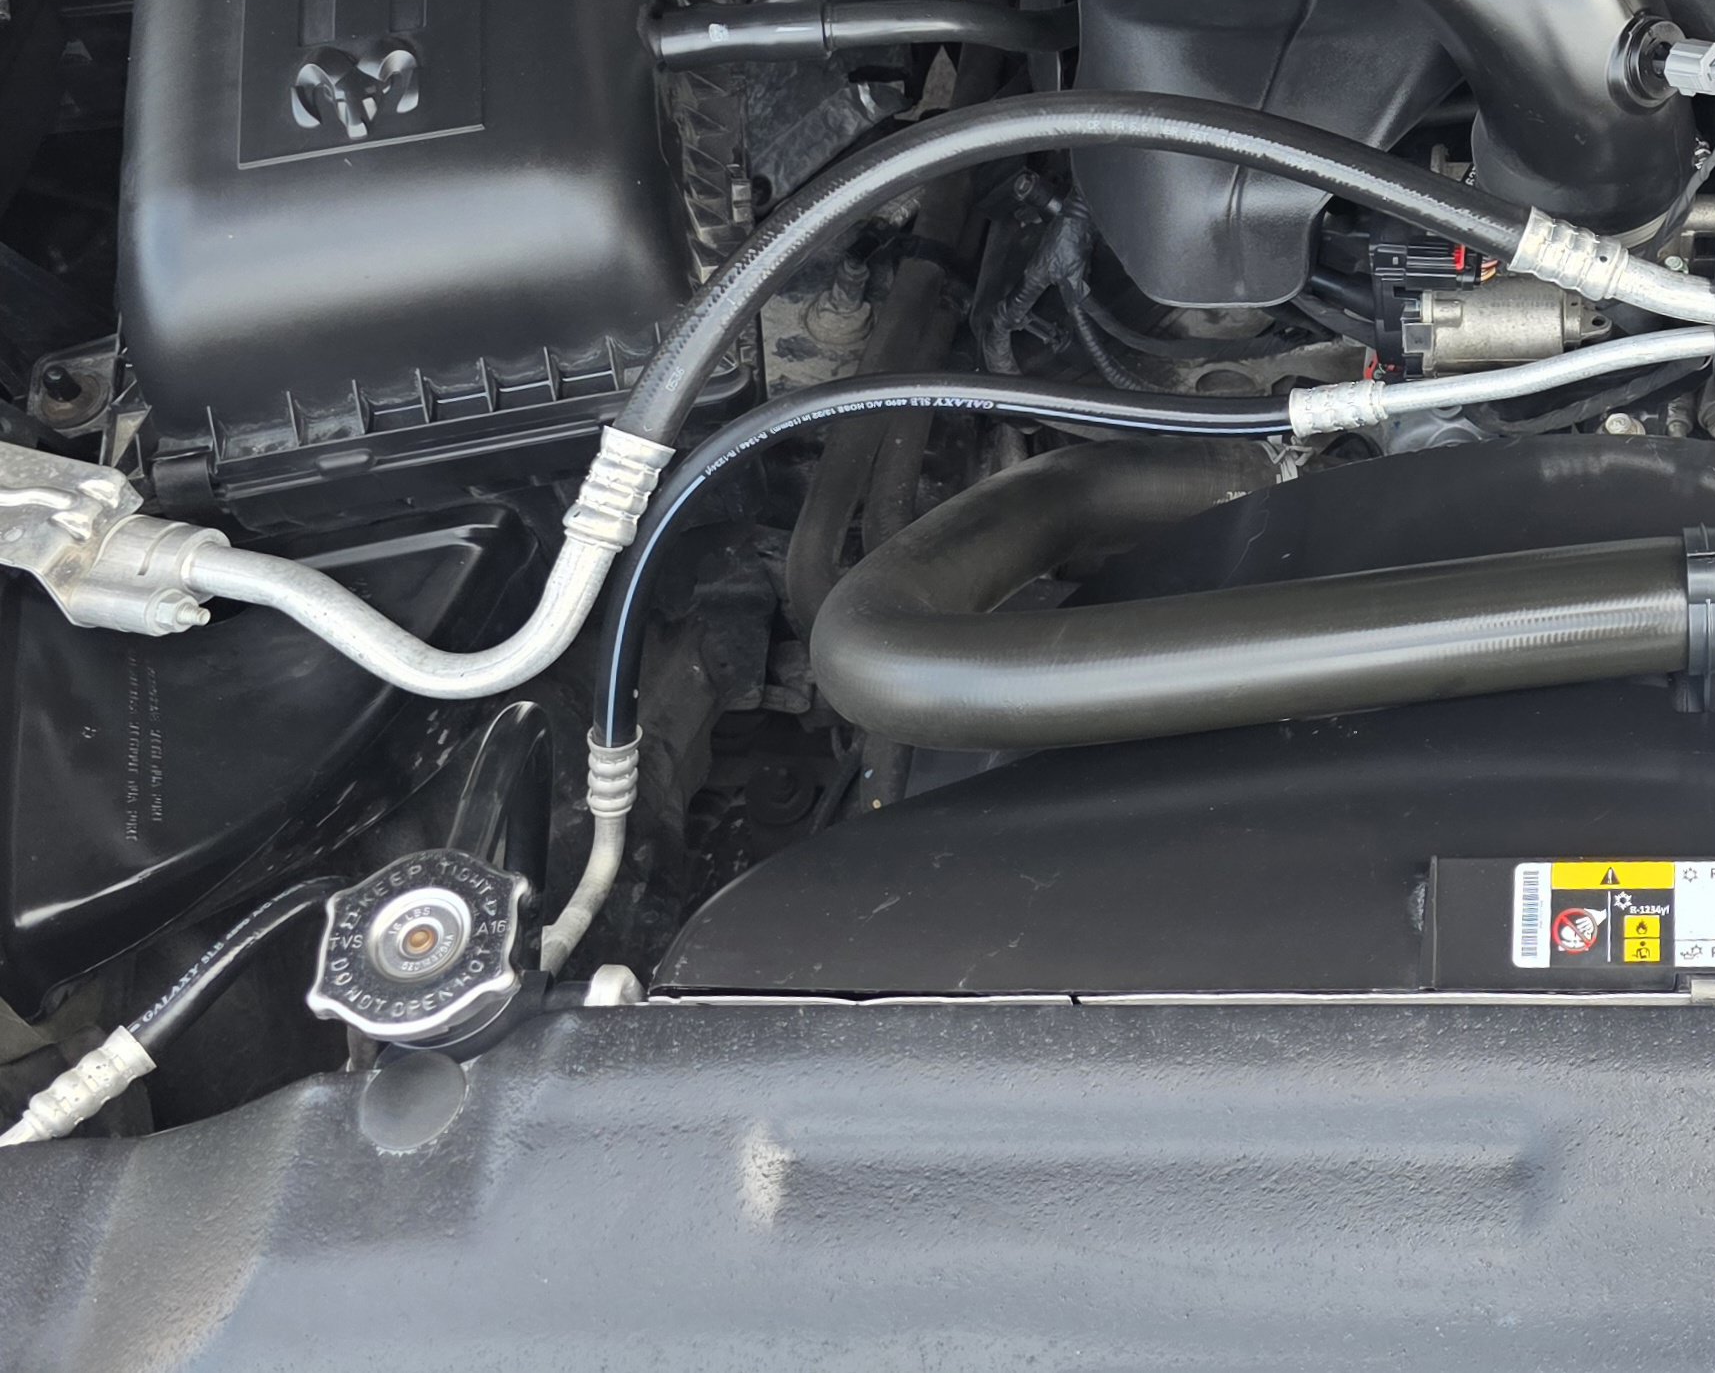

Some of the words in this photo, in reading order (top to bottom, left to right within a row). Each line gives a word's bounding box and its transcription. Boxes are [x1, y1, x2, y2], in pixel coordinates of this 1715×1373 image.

[933, 397, 994, 410] GALAXY
[770, 416, 802, 435] (10mm)
[358, 864, 423, 907] KEEP
[436, 858, 494, 895] TIGHT
[405, 906, 431, 921] LBS
[1629, 905, 1670, 917] R-1234yf
[474, 919, 508, 937] A16
[330, 934, 363, 951] TVS
[142, 963, 199, 1023] GALAXY
[331, 958, 353, 986] DO
[345, 986, 387, 1012] NOT
[391, 990, 454, 1018] OPEN
